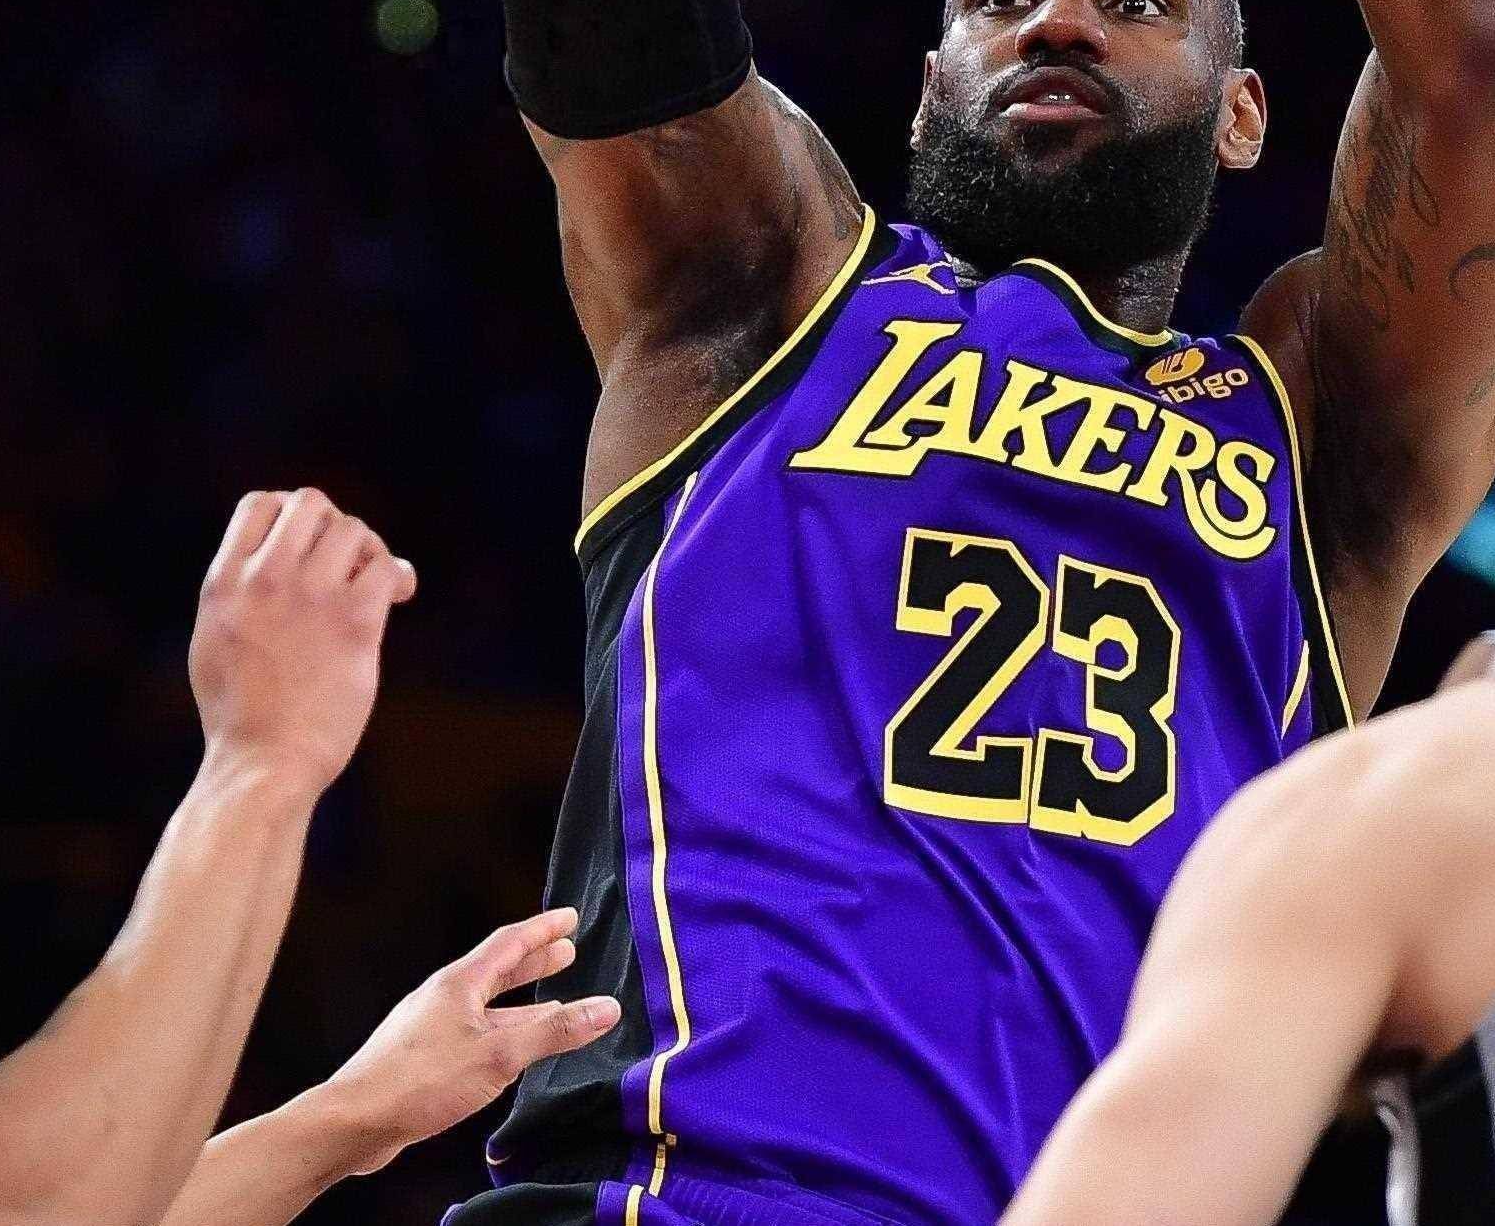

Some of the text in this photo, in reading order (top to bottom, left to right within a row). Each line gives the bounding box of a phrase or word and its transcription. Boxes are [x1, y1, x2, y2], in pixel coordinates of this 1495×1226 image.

[789, 319, 1276, 561] LAKERS
[1158, 368, 1249, 404] ibigo
[883, 527, 1181, 848] 23
